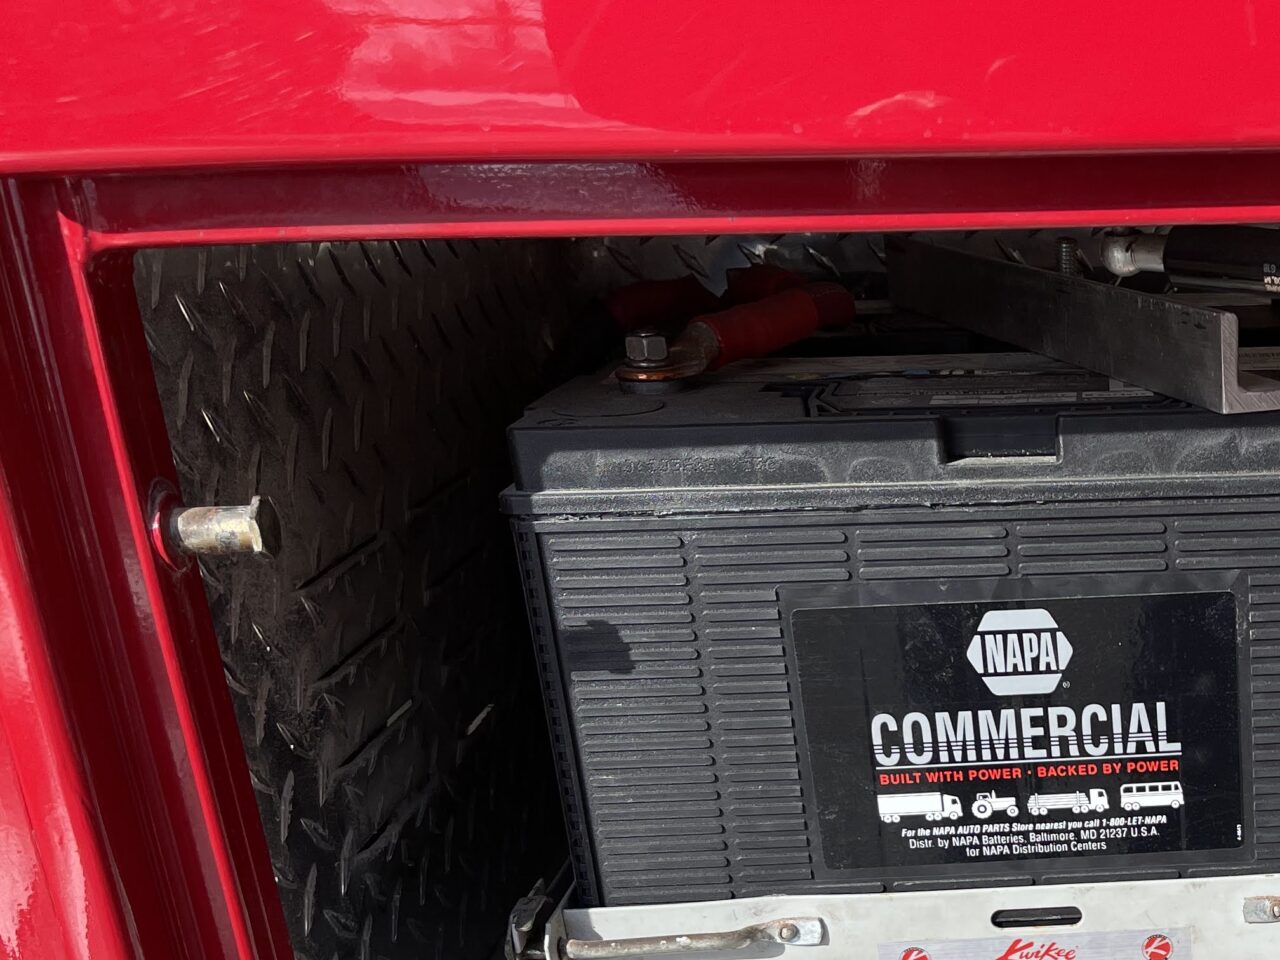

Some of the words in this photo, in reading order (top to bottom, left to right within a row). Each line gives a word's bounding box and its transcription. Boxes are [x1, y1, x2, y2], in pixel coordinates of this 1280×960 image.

[984, 631, 1058, 674] NAPA
[871, 701, 1182, 767] COMMERCIAL
[879, 772, 921, 785] BUILT
[925, 771, 964, 783] WITH
[968, 767, 1022, 781] POWER
[1037, 763, 1098, 778] BACKED
[1102, 762, 1121, 774] BY
[1126, 759, 1179, 773] POWER
[901, 828, 916, 837] For
[917, 828, 931, 836] the
[932, 826, 955, 835] NAPA
[957, 825, 981, 834] AUTO
[982, 823, 1010, 833] PARTS
[1012, 822, 1034, 831] Store
[1035, 820, 1066, 830] nearest
[1067, 820, 1083, 830] you
[1084, 818, 1100, 827] call
[1102, 815, 1167, 827] 1-800-LET-NAPA
[938, 838, 949, 849] by
[952, 836, 980, 846] NAPA
[1080, 829, 1098, 840] MD
[1100, 828, 1128, 839] 21237
[1130, 826, 1160, 837] U.S.A.
[966, 847, 980, 857] for
[982, 845, 1010, 856] NAPA
[1012, 840, 1068, 854] Distribution
[1070, 841, 1107, 851] Centers
